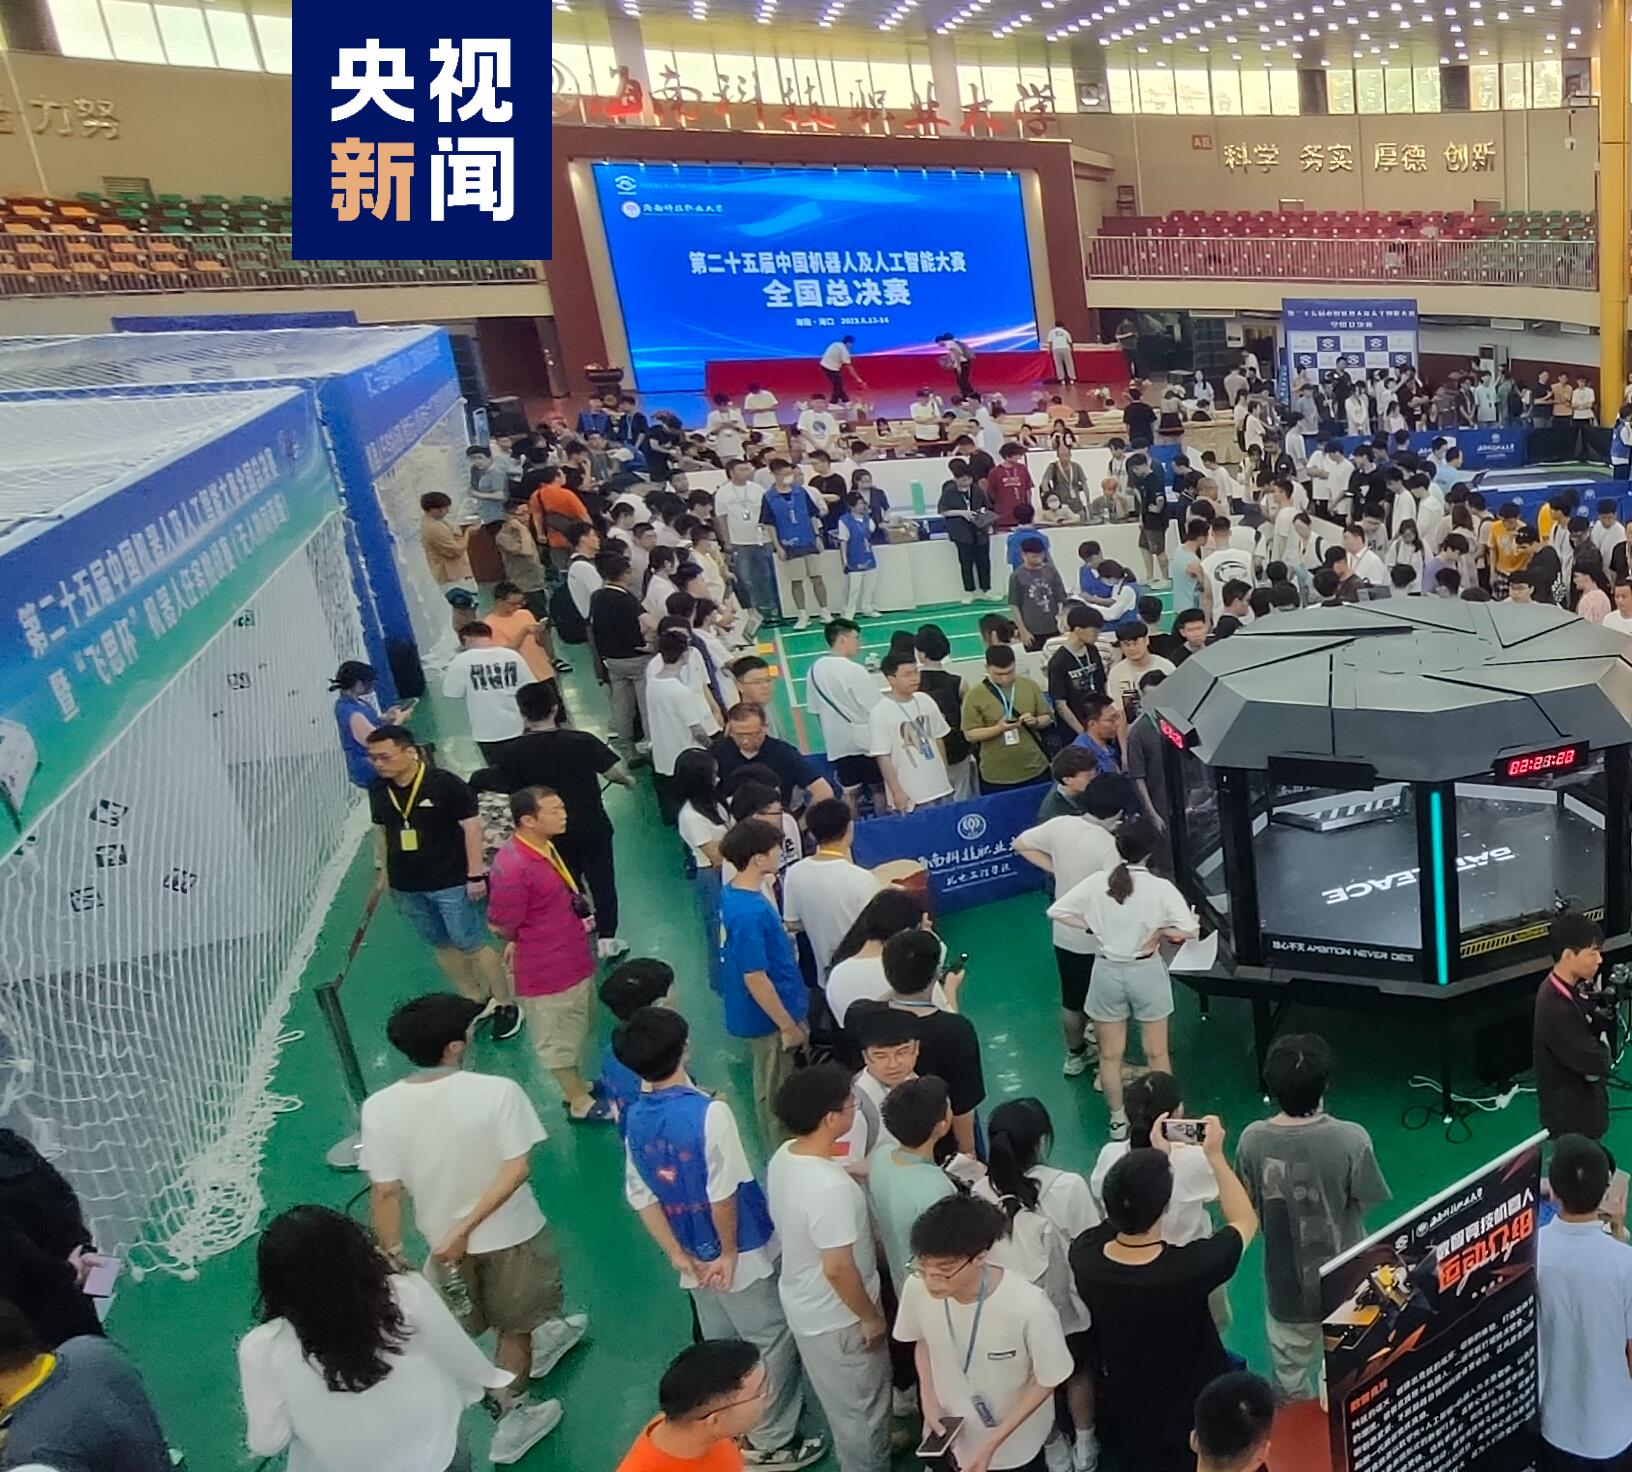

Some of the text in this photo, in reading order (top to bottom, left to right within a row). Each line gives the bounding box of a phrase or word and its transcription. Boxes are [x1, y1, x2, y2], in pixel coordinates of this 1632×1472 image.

[1223, 140, 1497, 173] 科学 务实 厚德 创新
[689, 251, 967, 275] 第二十五届中国机器人及人工智能大赛
[762, 278, 912, 308] 全国总决赛
[1307, 945, 1352, 956] AMBITION
[1353, 948, 1388, 960] NEVER
